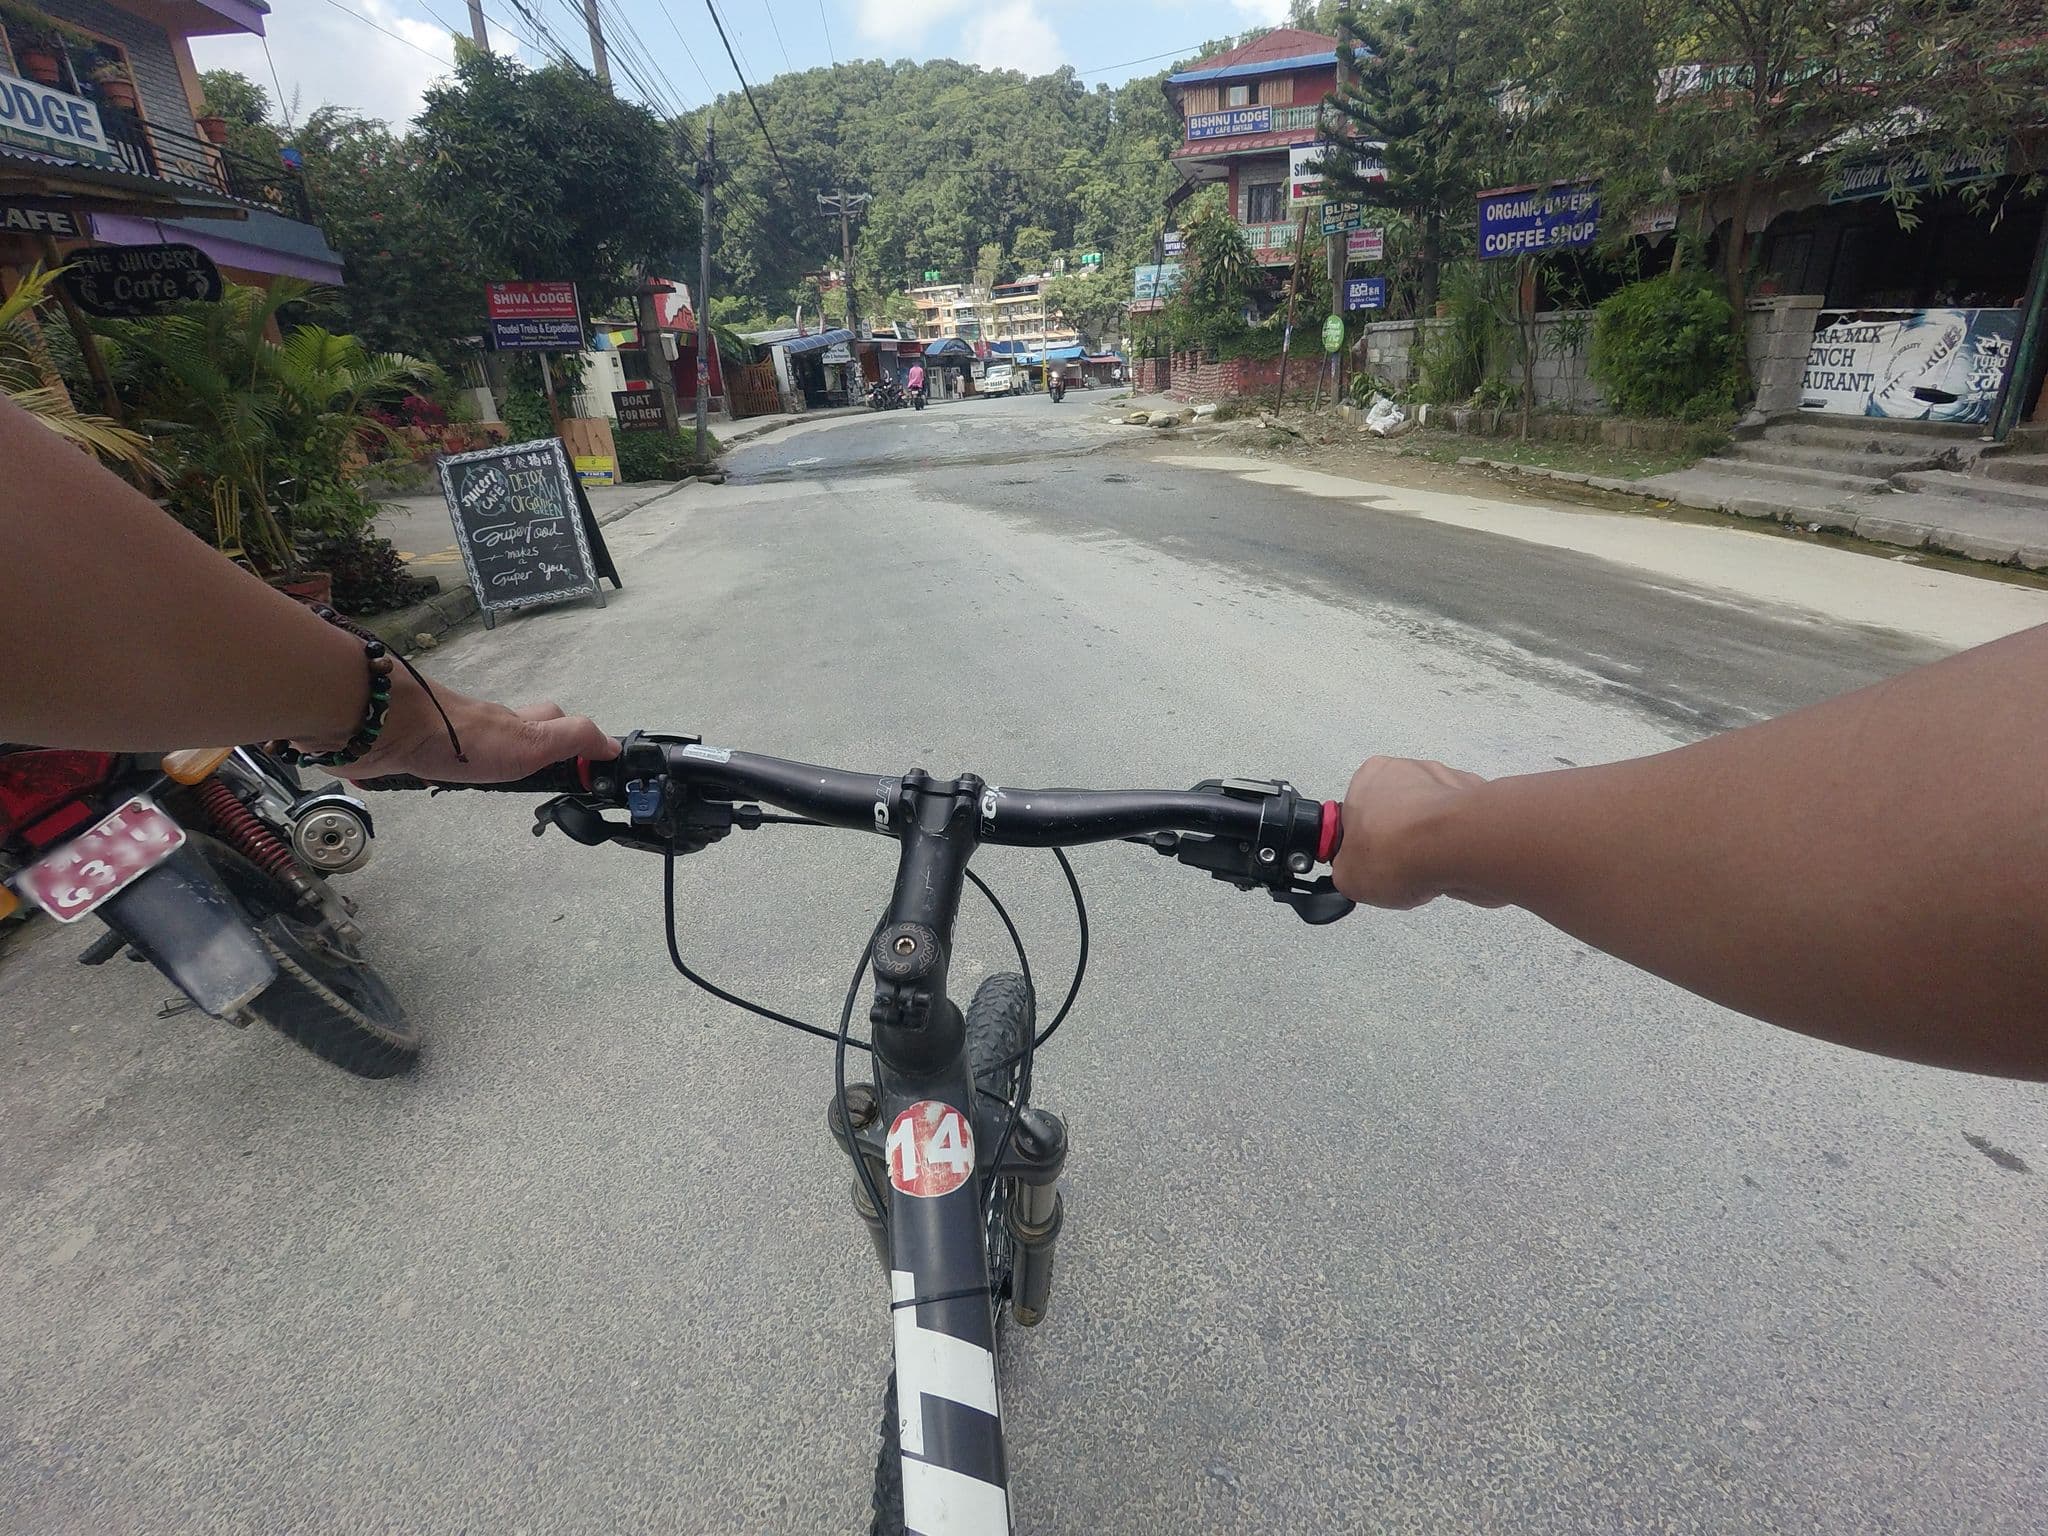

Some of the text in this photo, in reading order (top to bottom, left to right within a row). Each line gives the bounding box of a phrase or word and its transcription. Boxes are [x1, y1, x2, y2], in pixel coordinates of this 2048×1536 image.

[1191, 110, 1269, 129] BISHNU LODGE
[1215, 126, 1231, 134] CAFE
[0, 208, 73, 233] AFE
[1535, 217, 1542, 226] &
[1485, 229, 1546, 252] COFFEE
[114, 272, 178, 300] Cafe
[493, 292, 572, 304] SHIVA LODGE
[1801, 371, 1875, 392] AURANT
[621, 395, 650, 406] BOAT
[619, 408, 661, 420] FOR RENT
[889, 1112, 970, 1181] 14
